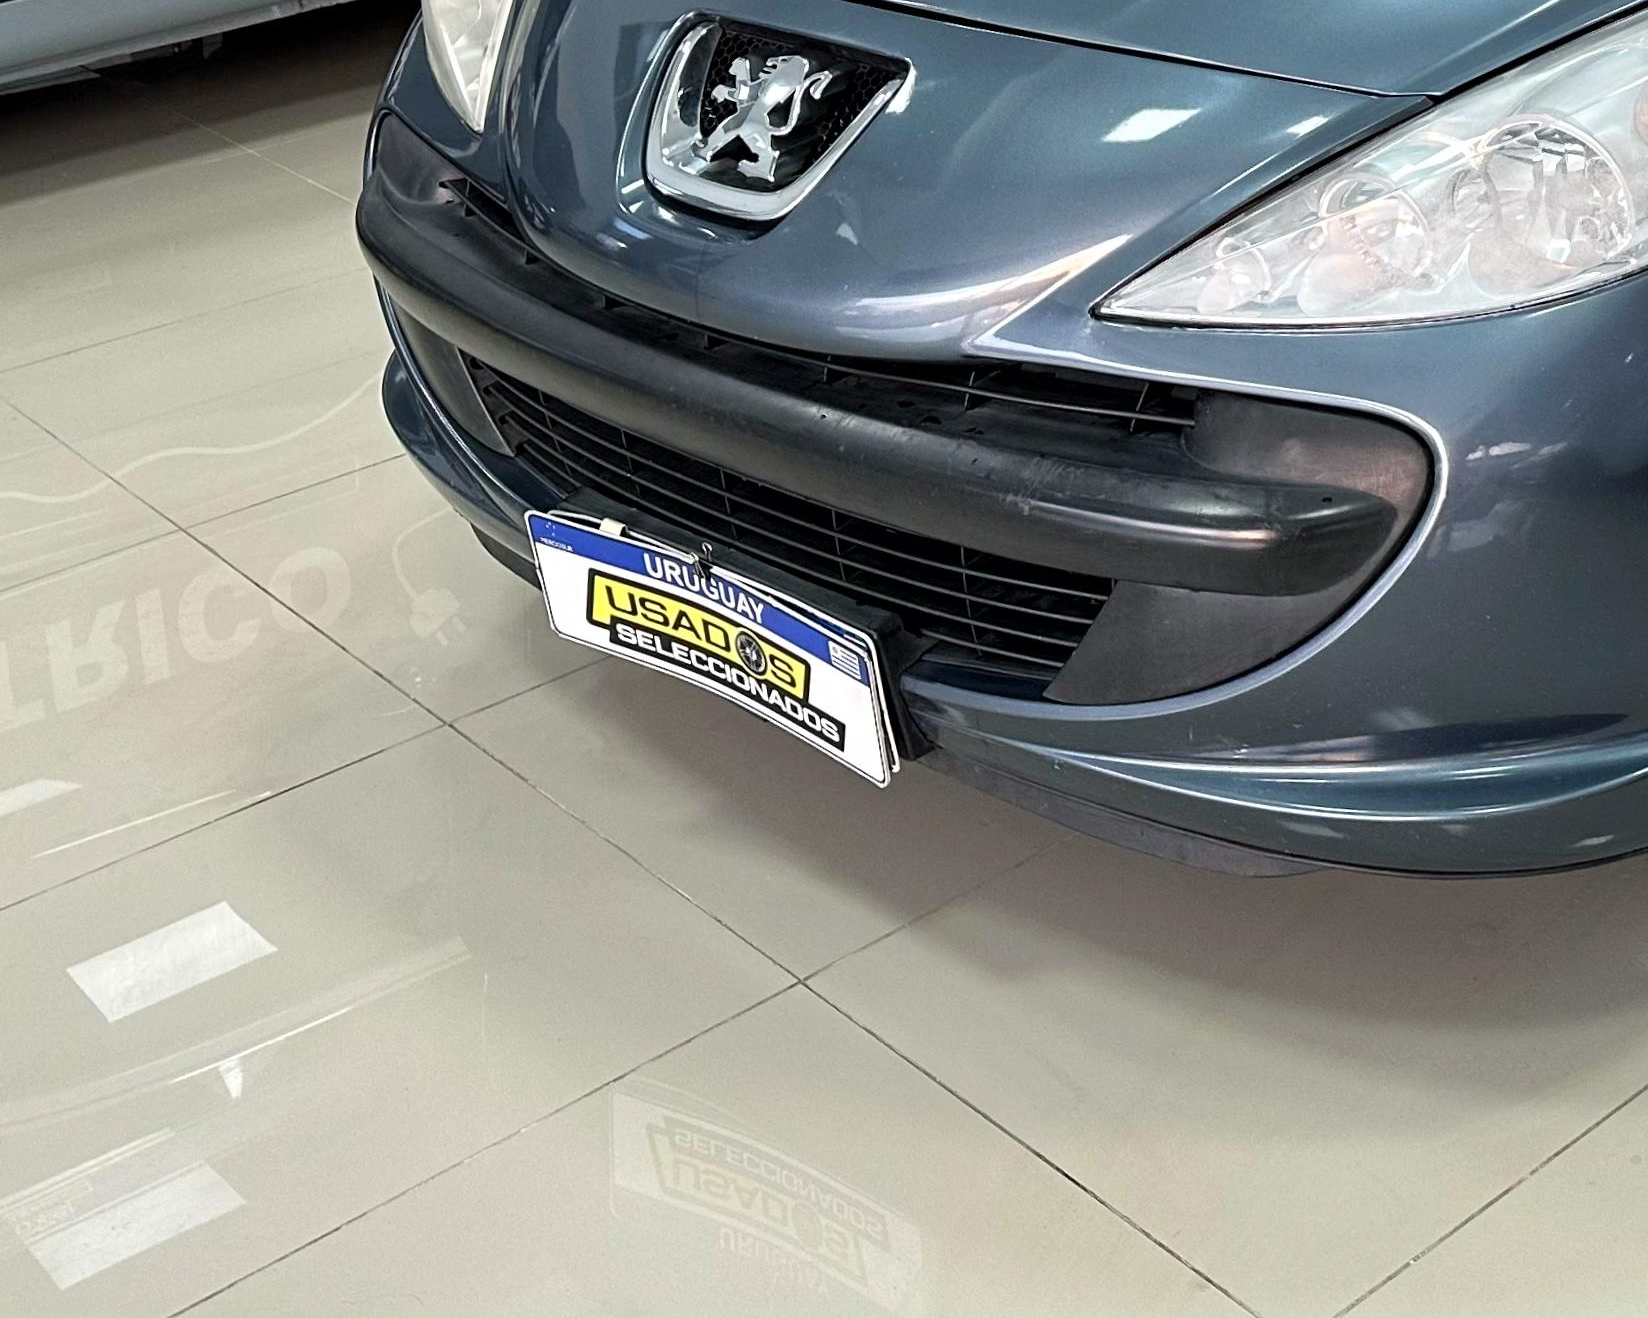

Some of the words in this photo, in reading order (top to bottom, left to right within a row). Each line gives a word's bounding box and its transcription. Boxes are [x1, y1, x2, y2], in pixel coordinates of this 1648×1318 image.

[604, 584, 797, 688] USADOS
[643, 553, 765, 624] URUGUAY
[615, 623, 841, 743] SELECCIONADOS
